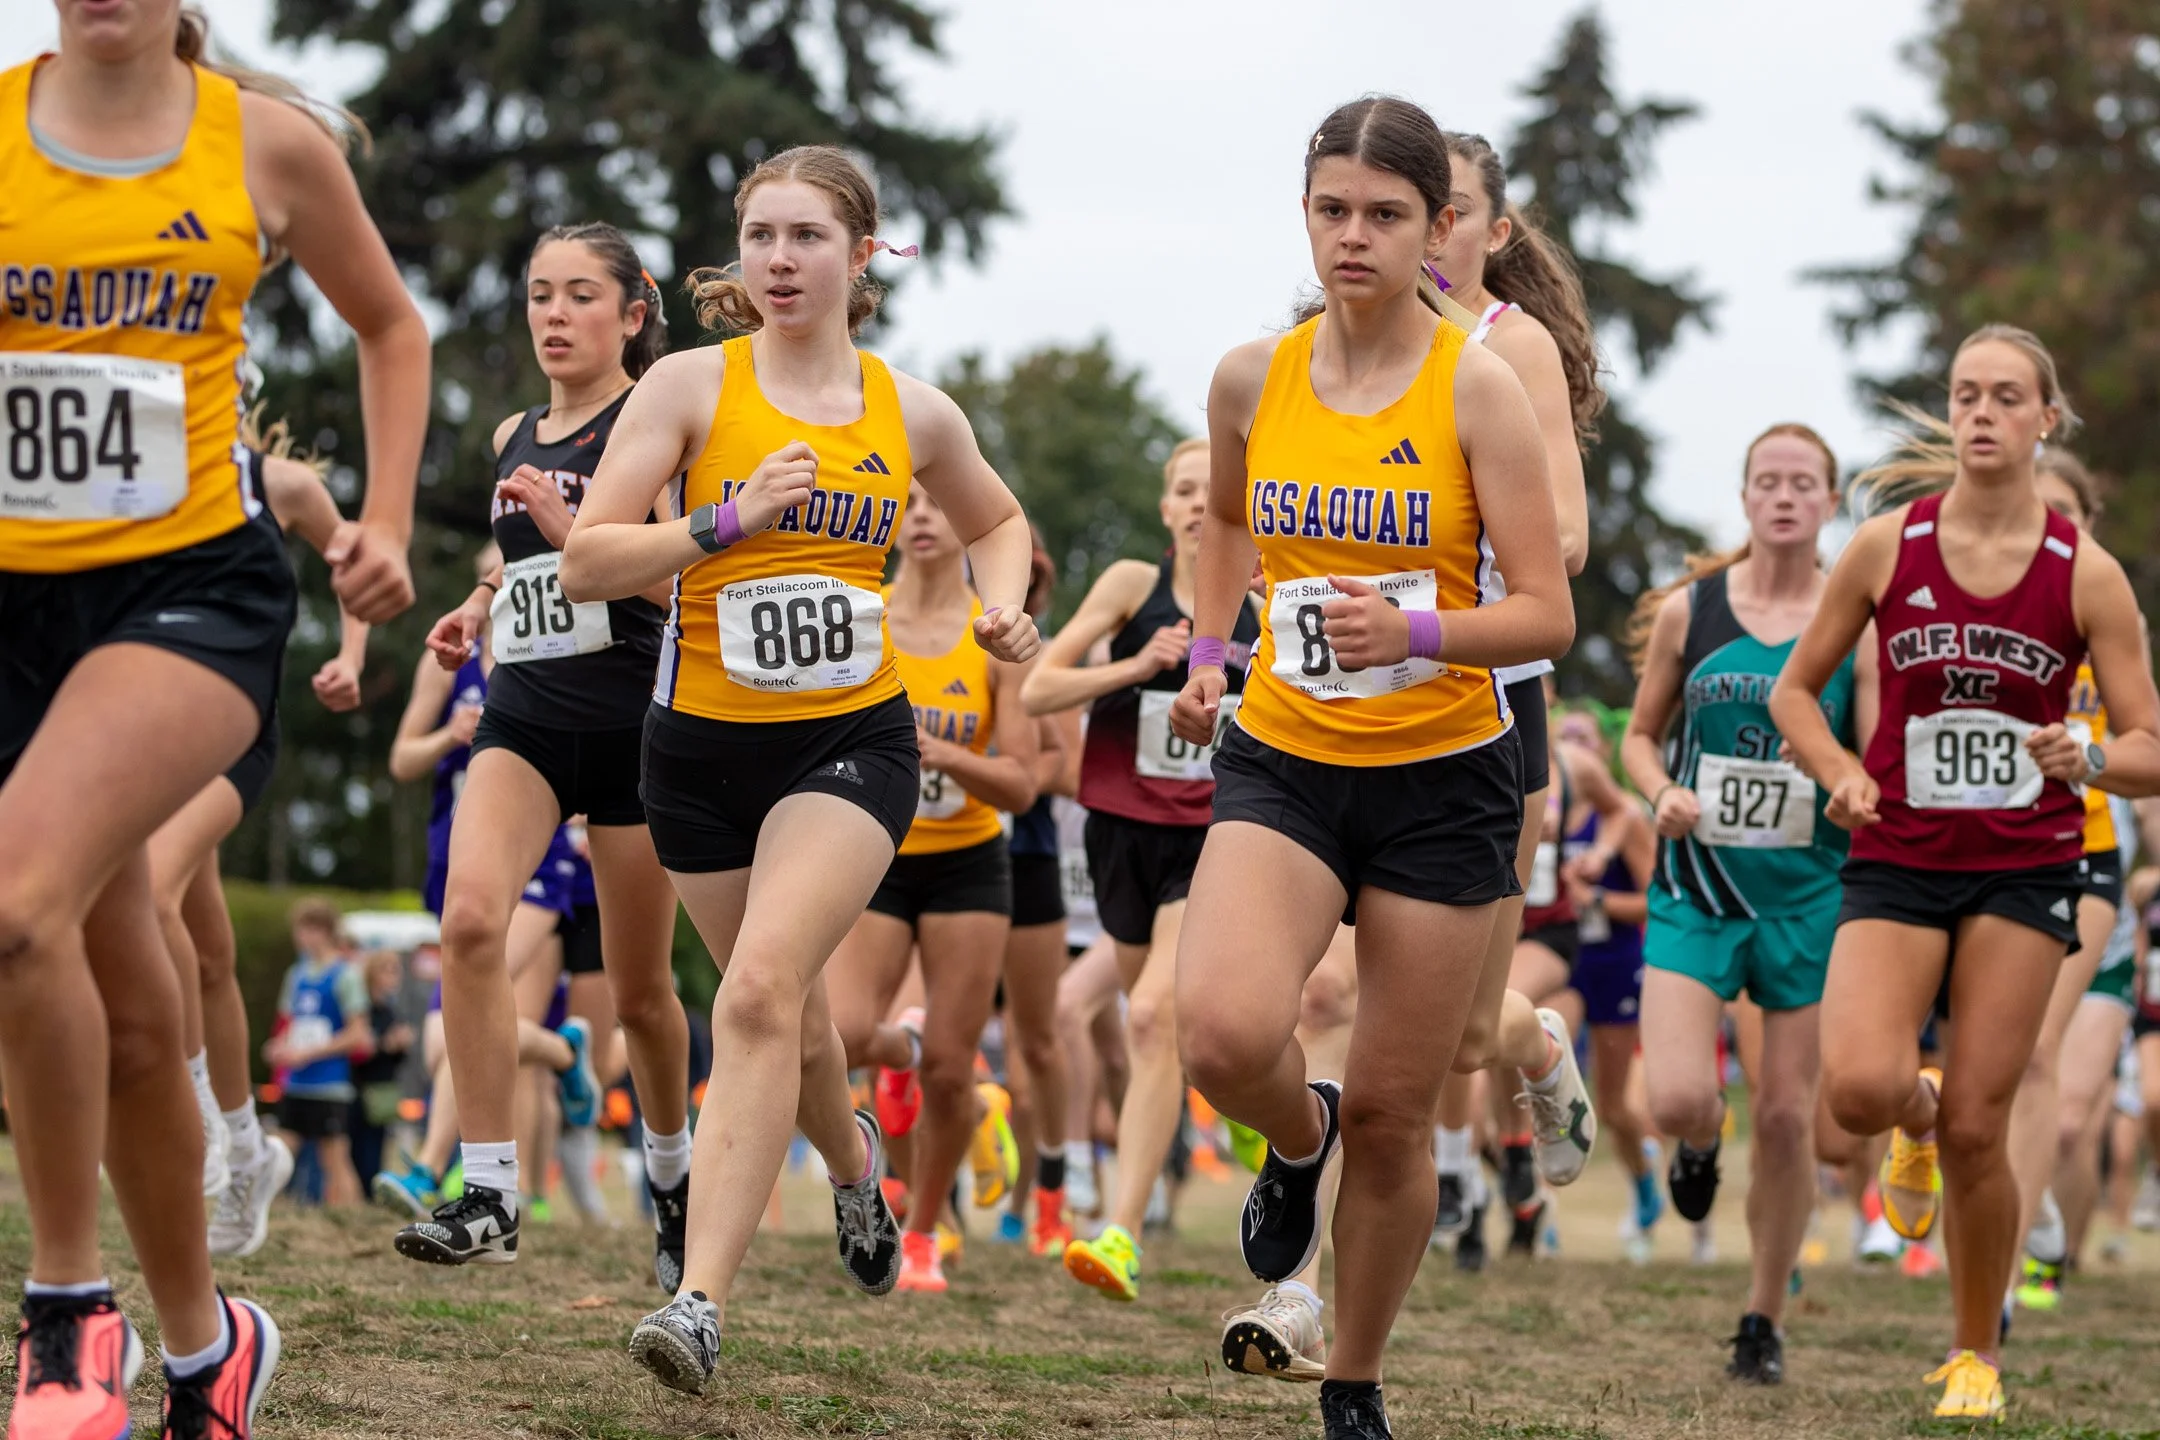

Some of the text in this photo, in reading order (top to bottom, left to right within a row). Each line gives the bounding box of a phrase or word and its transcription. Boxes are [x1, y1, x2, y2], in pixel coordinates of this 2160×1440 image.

[0, 264, 220, 336] SSAQUAH
[7, 386, 141, 484] 864
[722, 479, 898, 547] IAQUAH
[1252, 479, 1432, 548] ISSAQUAH
[510, 573, 574, 638] 913
[727, 580, 828, 601] Fort Steilacoom
[1279, 590, 1299, 600] Fort
[1379, 578, 1419, 592] Invite
[751, 594, 854, 670] 868
[1888, 624, 2067, 686] W.F. WEST
[1940, 664, 2001, 705] XC
[817, 768, 865, 786] adidas
[1936, 730, 2017, 786] 963
[1720, 775, 1789, 829] 927
